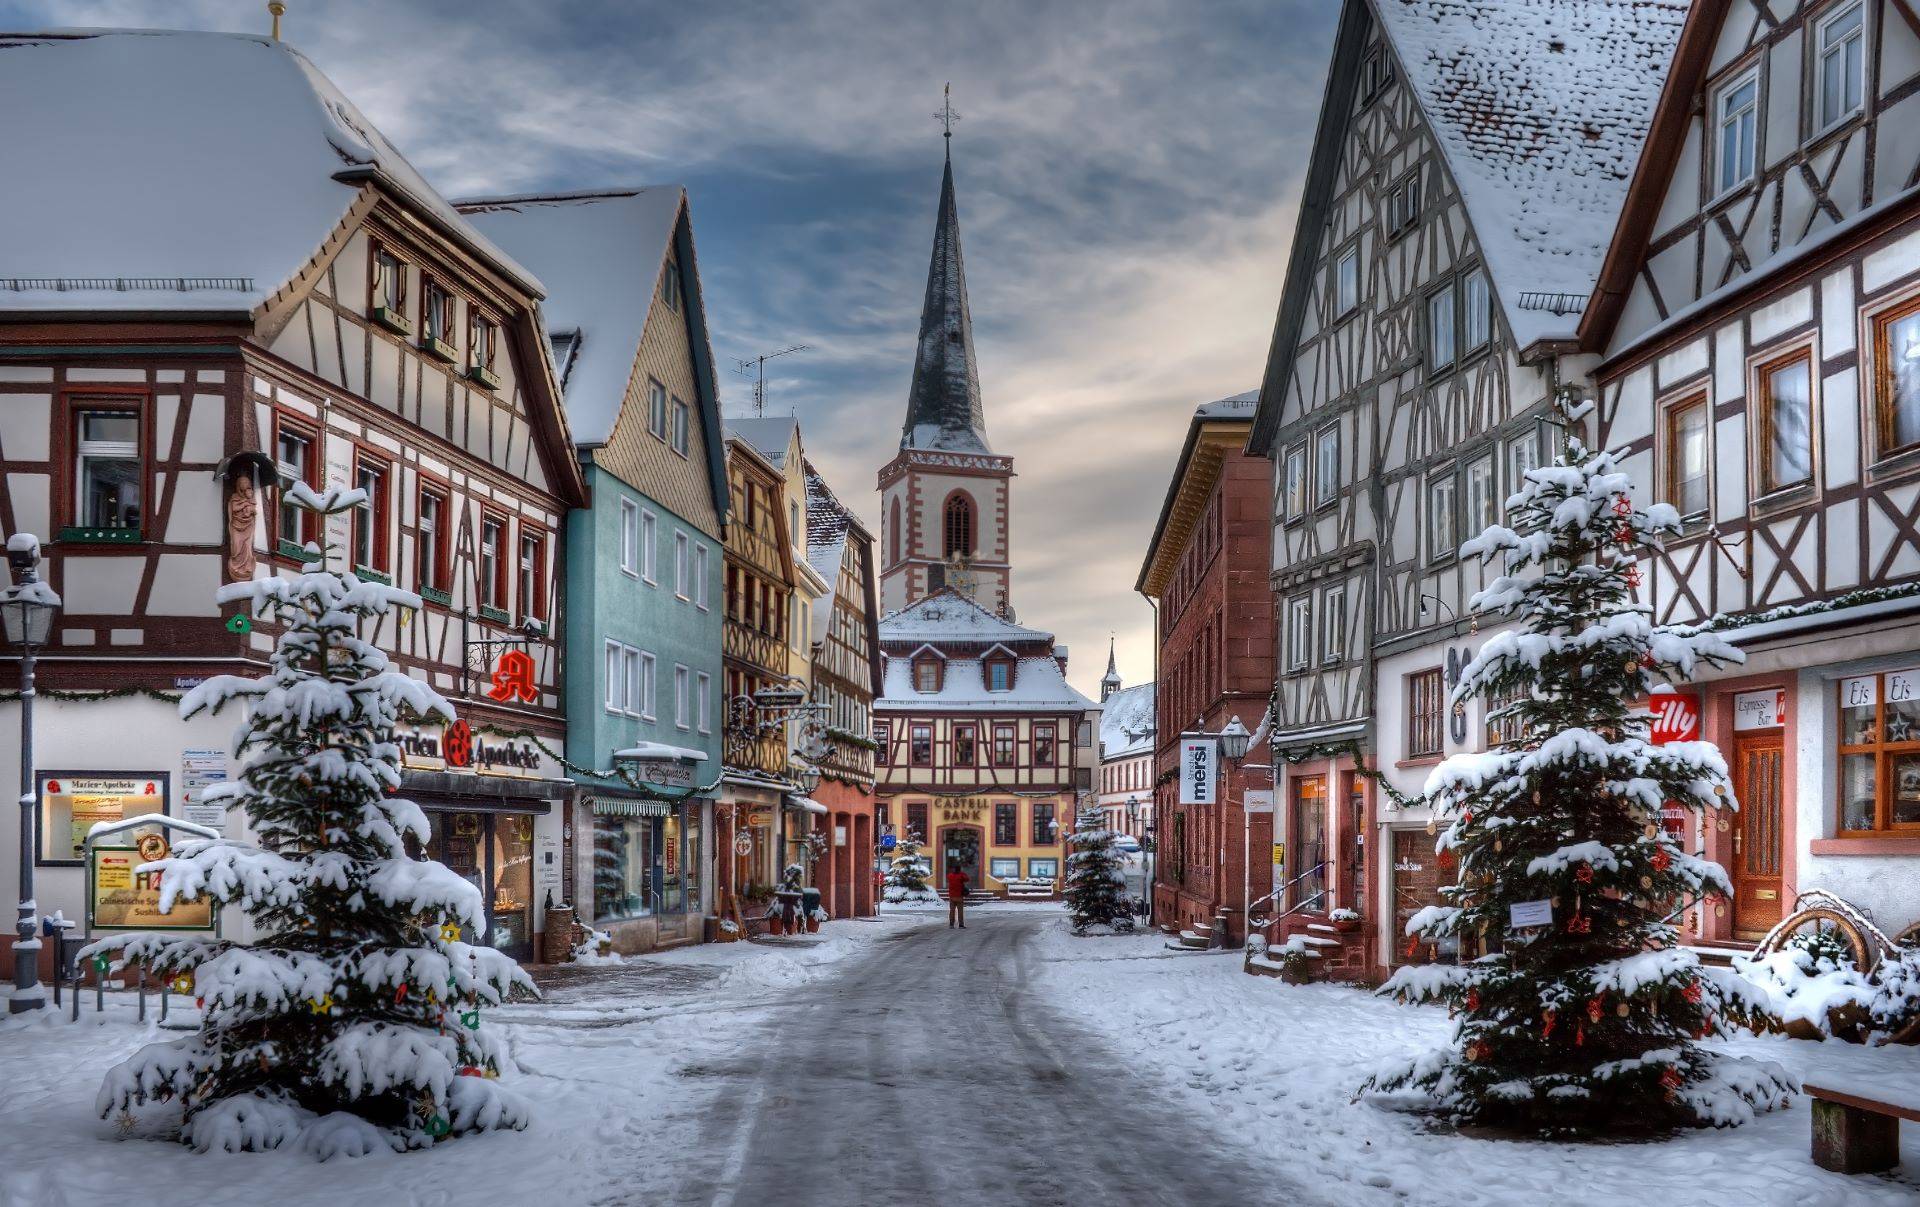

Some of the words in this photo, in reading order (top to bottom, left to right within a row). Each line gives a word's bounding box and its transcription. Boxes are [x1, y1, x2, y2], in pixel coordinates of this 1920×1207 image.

[1850, 681, 1869, 705] Eis
[1890, 675, 1911, 701] Eis
[1653, 700, 1698, 740] illy
[1188, 746, 1206, 801] mersi
[934, 797, 990, 809] CASTELL
[943, 810, 981, 820] BANK
